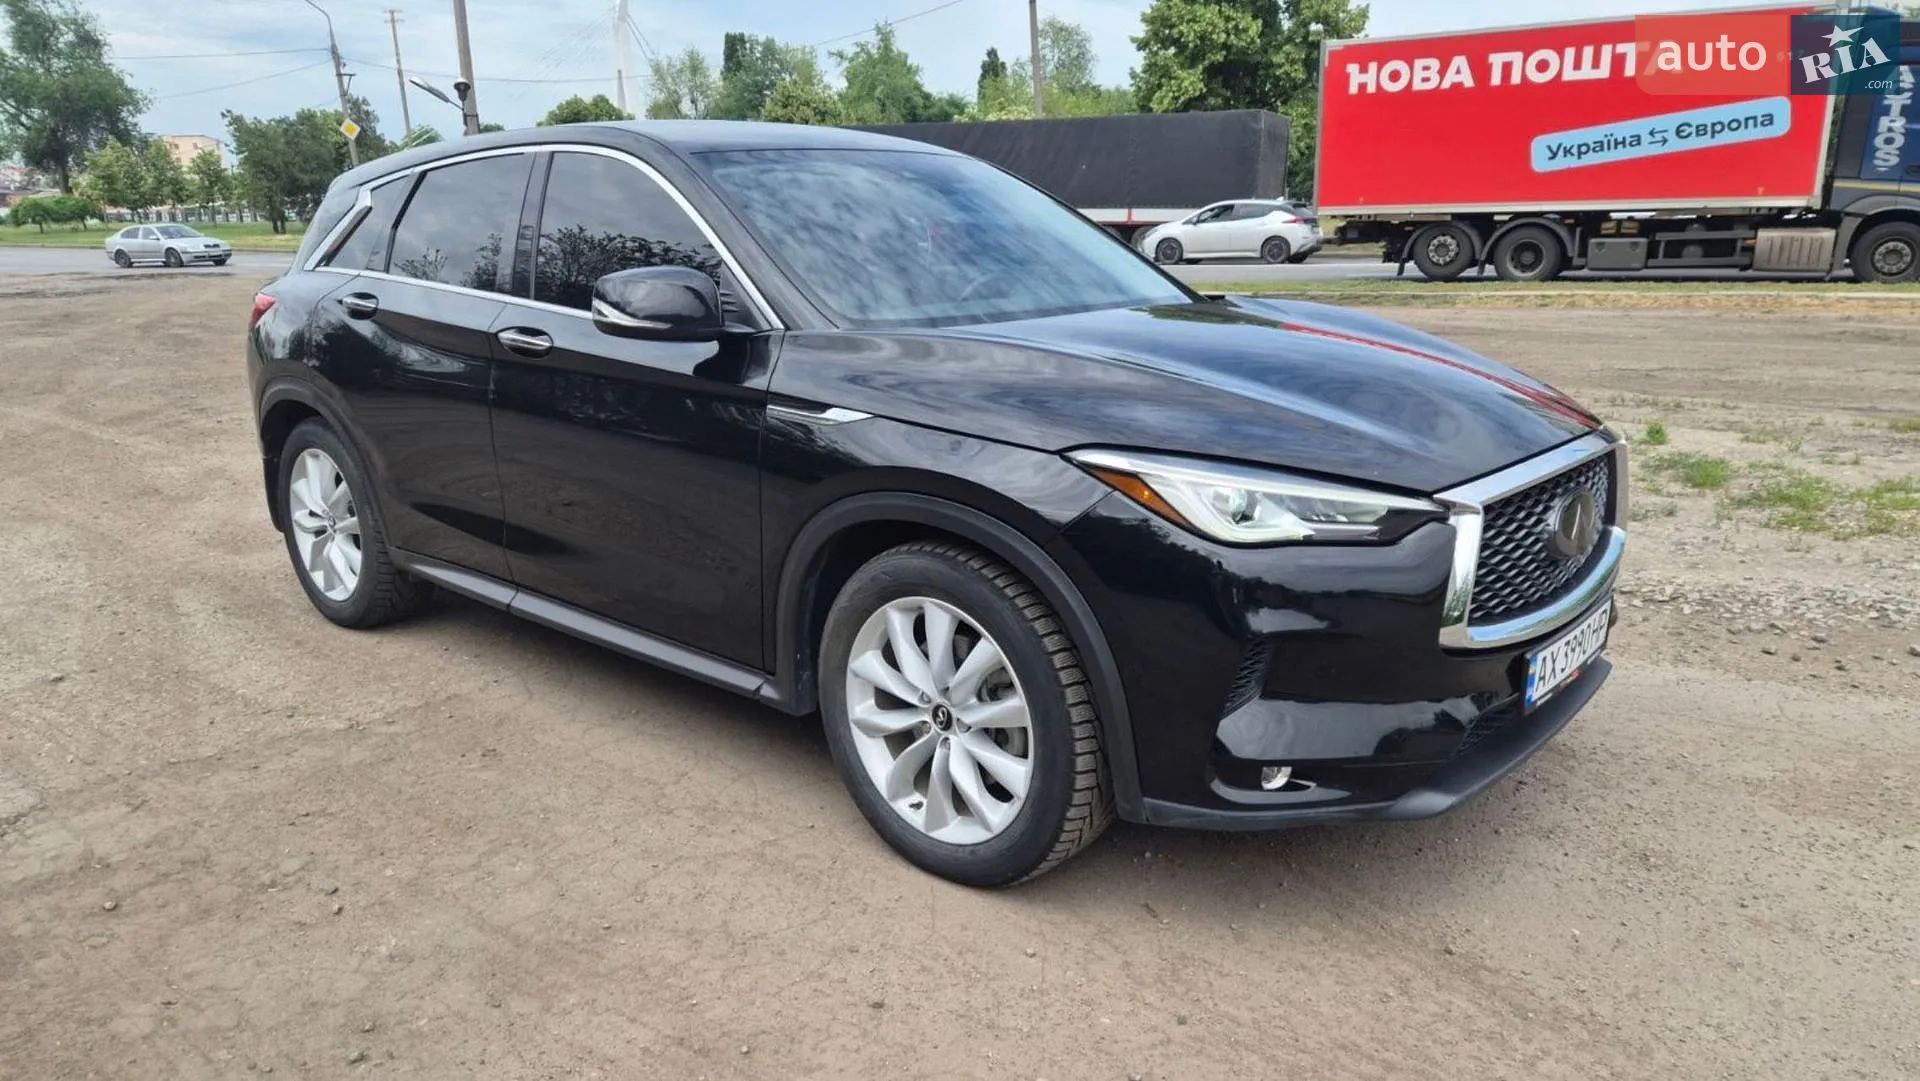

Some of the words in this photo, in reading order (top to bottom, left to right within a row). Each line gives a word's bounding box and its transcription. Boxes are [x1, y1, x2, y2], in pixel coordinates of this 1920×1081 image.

[1345, 55, 1475, 95] НОВА
[1546, 133, 1641, 161] Україна
[1675, 112, 1774, 139] Європа
